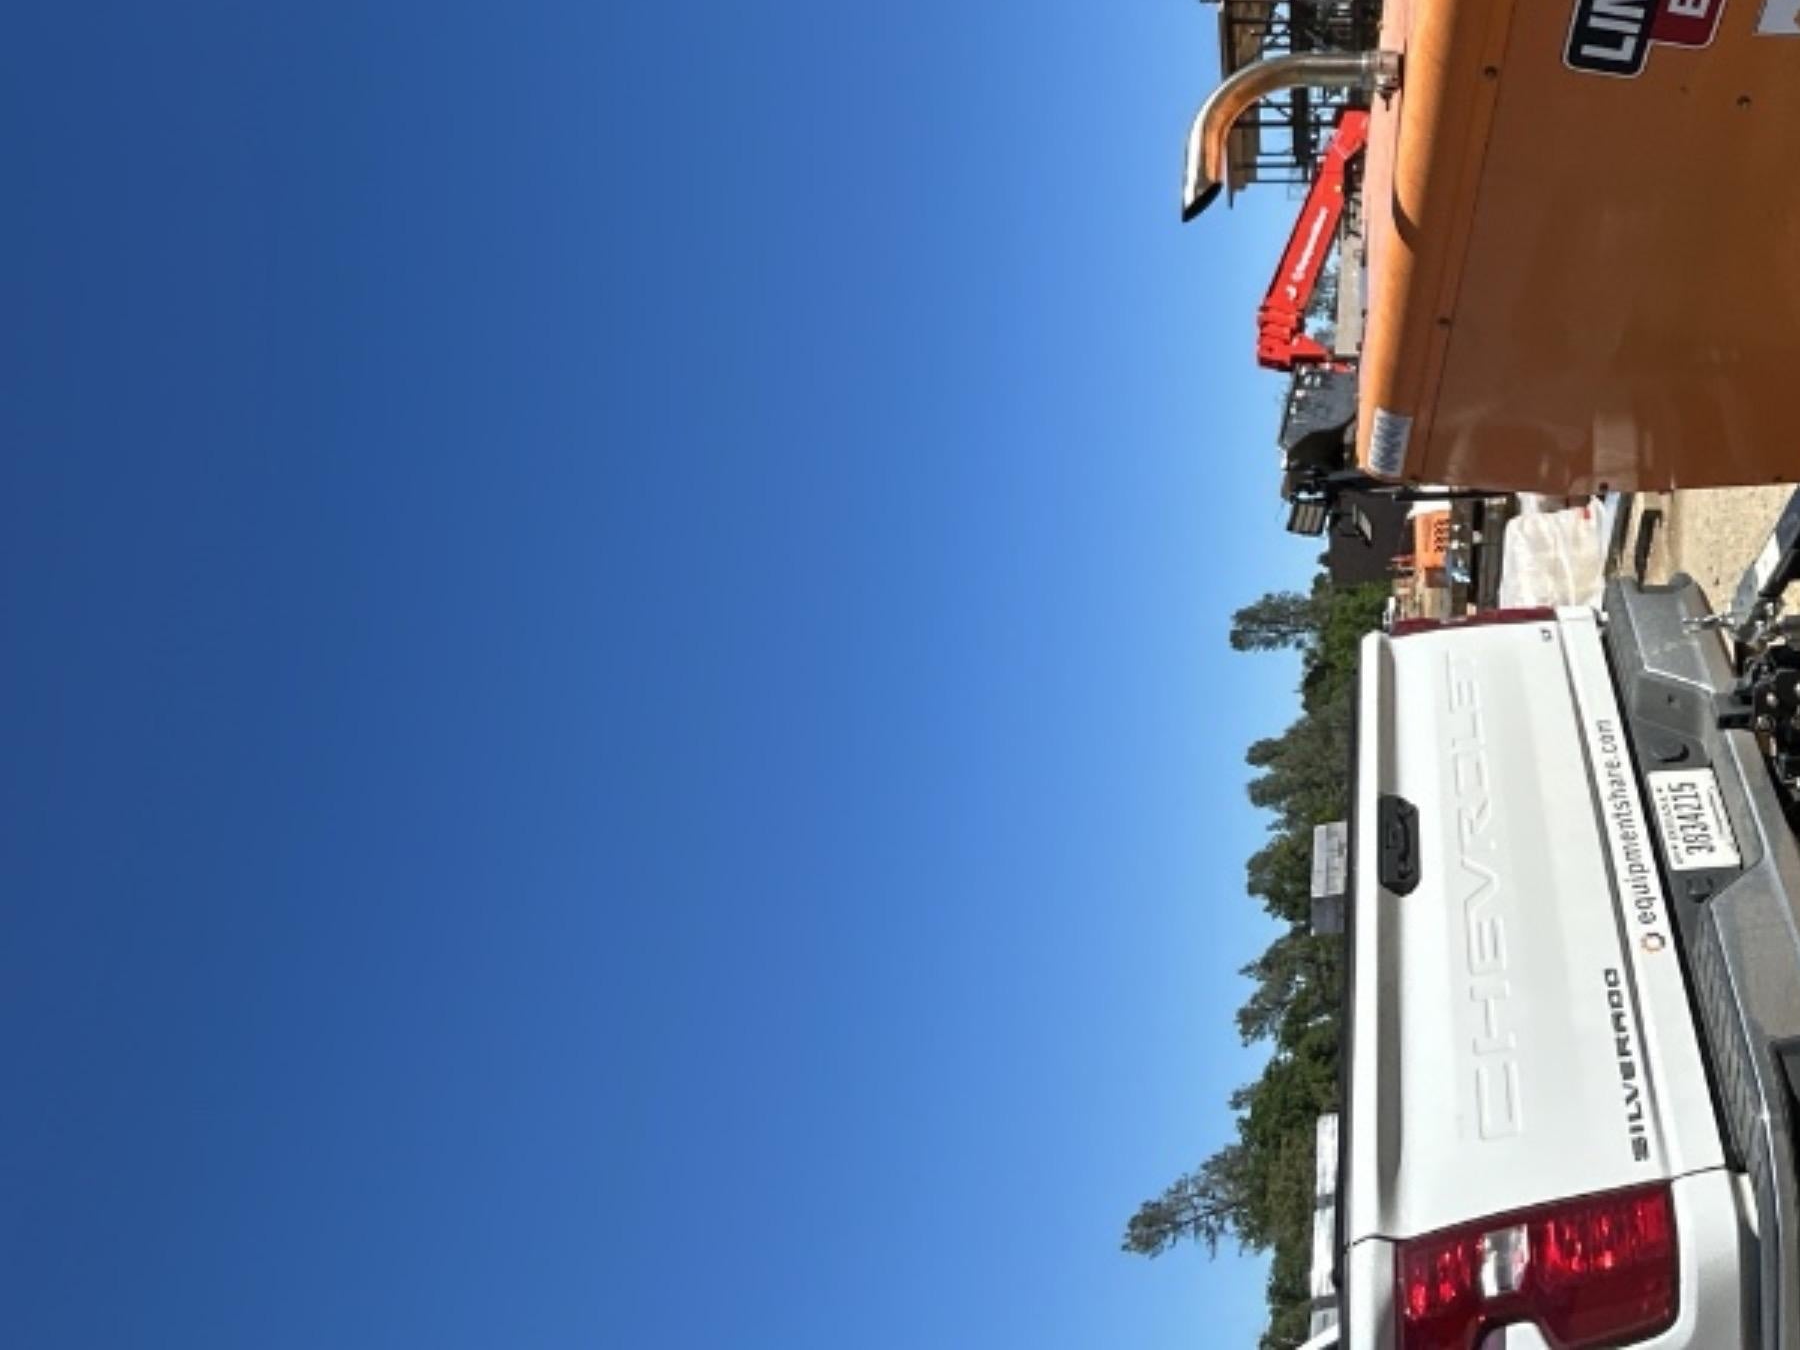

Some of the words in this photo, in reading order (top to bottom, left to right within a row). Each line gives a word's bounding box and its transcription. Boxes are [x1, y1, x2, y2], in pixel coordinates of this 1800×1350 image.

[1445, 650, 1522, 1140] CHEVROLET
[1595, 720, 1657, 925] equipmentshare.com
[1667, 783, 1716, 855] 3834215
[1604, 968, 1649, 1162] SILVERADO
